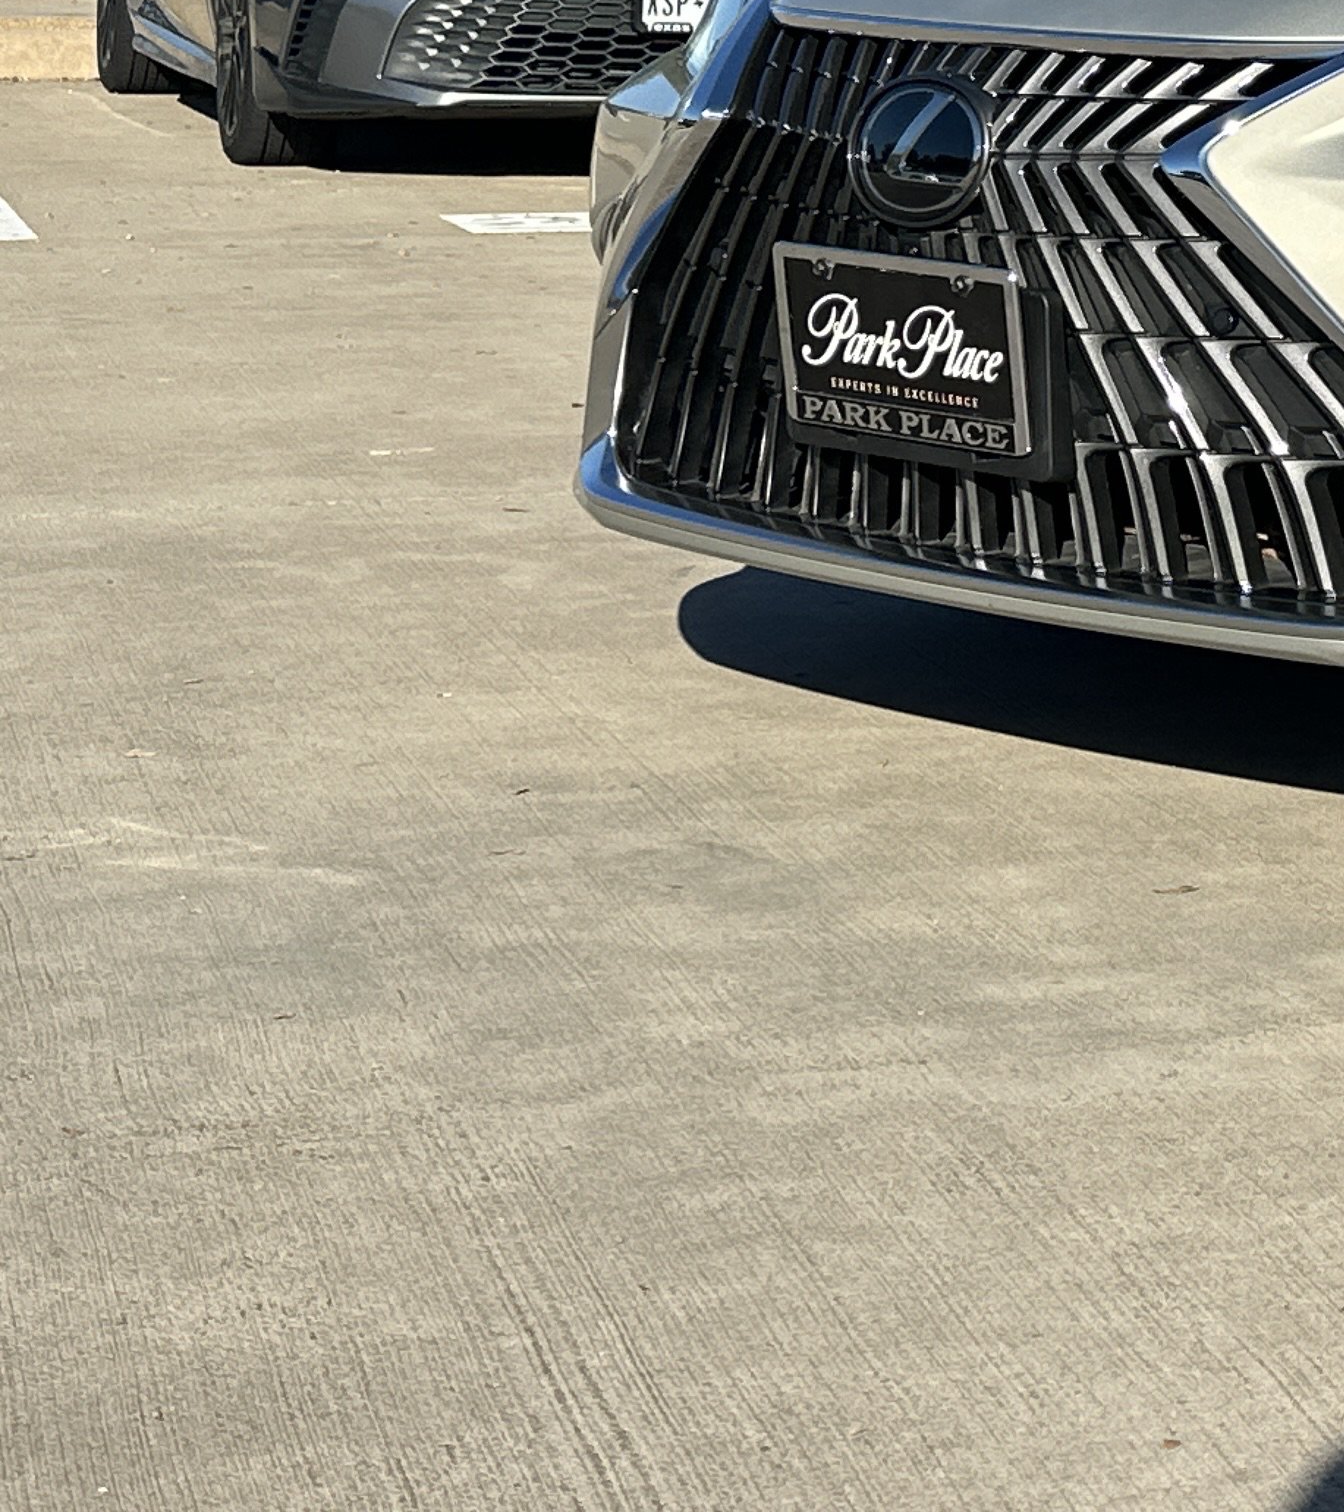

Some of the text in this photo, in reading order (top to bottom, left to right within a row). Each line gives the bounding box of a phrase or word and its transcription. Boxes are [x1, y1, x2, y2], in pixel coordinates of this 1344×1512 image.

[801, 293, 1004, 383] Park Place
[830, 376, 979, 409] EXPERTS IN EXCELLENCE
[803, 396, 1008, 449] PARK PLACE
